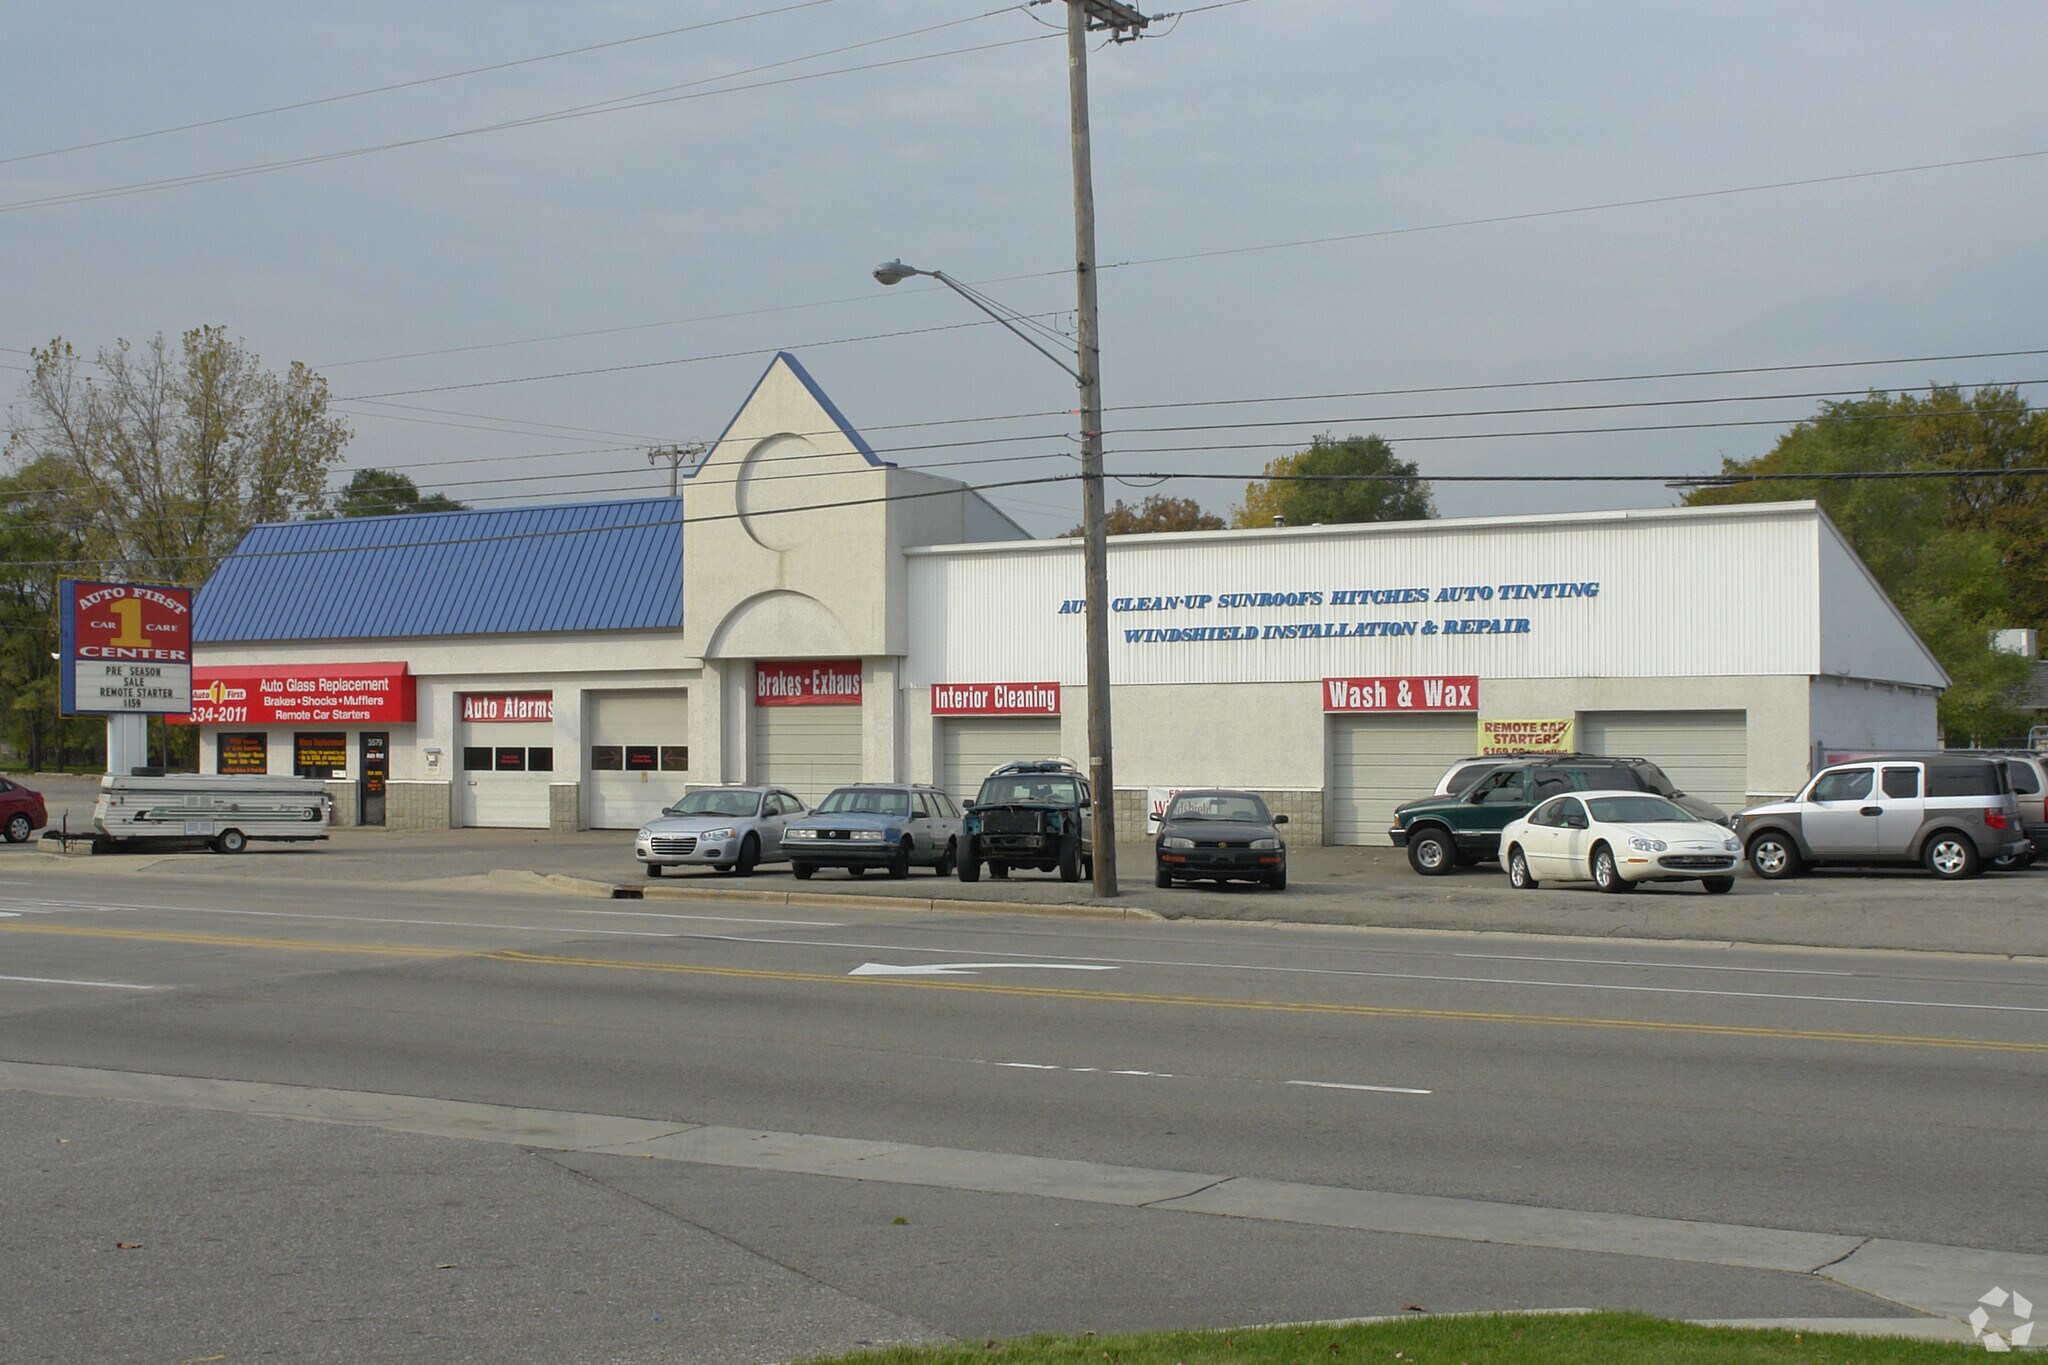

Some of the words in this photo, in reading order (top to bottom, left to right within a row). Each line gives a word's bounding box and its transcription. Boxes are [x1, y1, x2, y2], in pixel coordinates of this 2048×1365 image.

[79, 587, 125, 610] AUTO
[132, 587, 187, 615] FIRST
[1058, 600, 1087, 614] AU
[1218, 591, 1323, 608] SUNROOFS
[1329, 587, 1430, 605] HITCHES
[1434, 586, 1493, 602] AUTO
[1498, 582, 1599, 600] TINTING
[90, 621, 116, 629] CAR
[110, 598, 152, 647] 1
[145, 623, 178, 632] CARE
[1124, 626, 1259, 643] WINDSHIELD
[1261, 621, 1418, 640] INSTALLATION
[1420, 620, 1439, 635] &
[1442, 618, 1531, 634] REPAIR
[79, 646, 186, 660] CENTER
[106, 666, 122, 676] PRE
[130, 666, 161, 677] SEASON
[124, 677, 144, 687] SALE
[260, 679, 283, 692] Auto
[286, 678, 316, 692] Glass
[319, 677, 389, 694] Replacement
[758, 671, 802, 696] Brakes
[812, 669, 862, 695] Exhaus
[100, 687, 133, 697] REMOTE
[137, 688, 173, 698] STARTER
[193, 691, 210, 699] Auto
[227, 690, 244, 699] First
[935, 686, 988, 708] Interior
[994, 685, 1055, 711] Cleaning
[1328, 681, 1387, 708] Wash
[1397, 679, 1413, 707] &
[1423, 680, 1472, 707] Wax
[123, 699, 141, 708] $159
[264, 696, 296, 706] Brakes
[302, 696, 337, 706] Shocks
[343, 695, 384, 706] Mufflers
[463, 696, 497, 718] Auto
[503, 696, 553, 718] Alarms
[275, 710, 311, 720] Remote
[313, 709, 330, 720] Car
[332, 709, 370, 719] Starters
[1484, 722, 1537, 733] REMOTE
[1540, 722, 1568, 733] CAR
[1493, 734, 1560, 744] STARTERS
[1483, 746, 1525, 755] $16900
